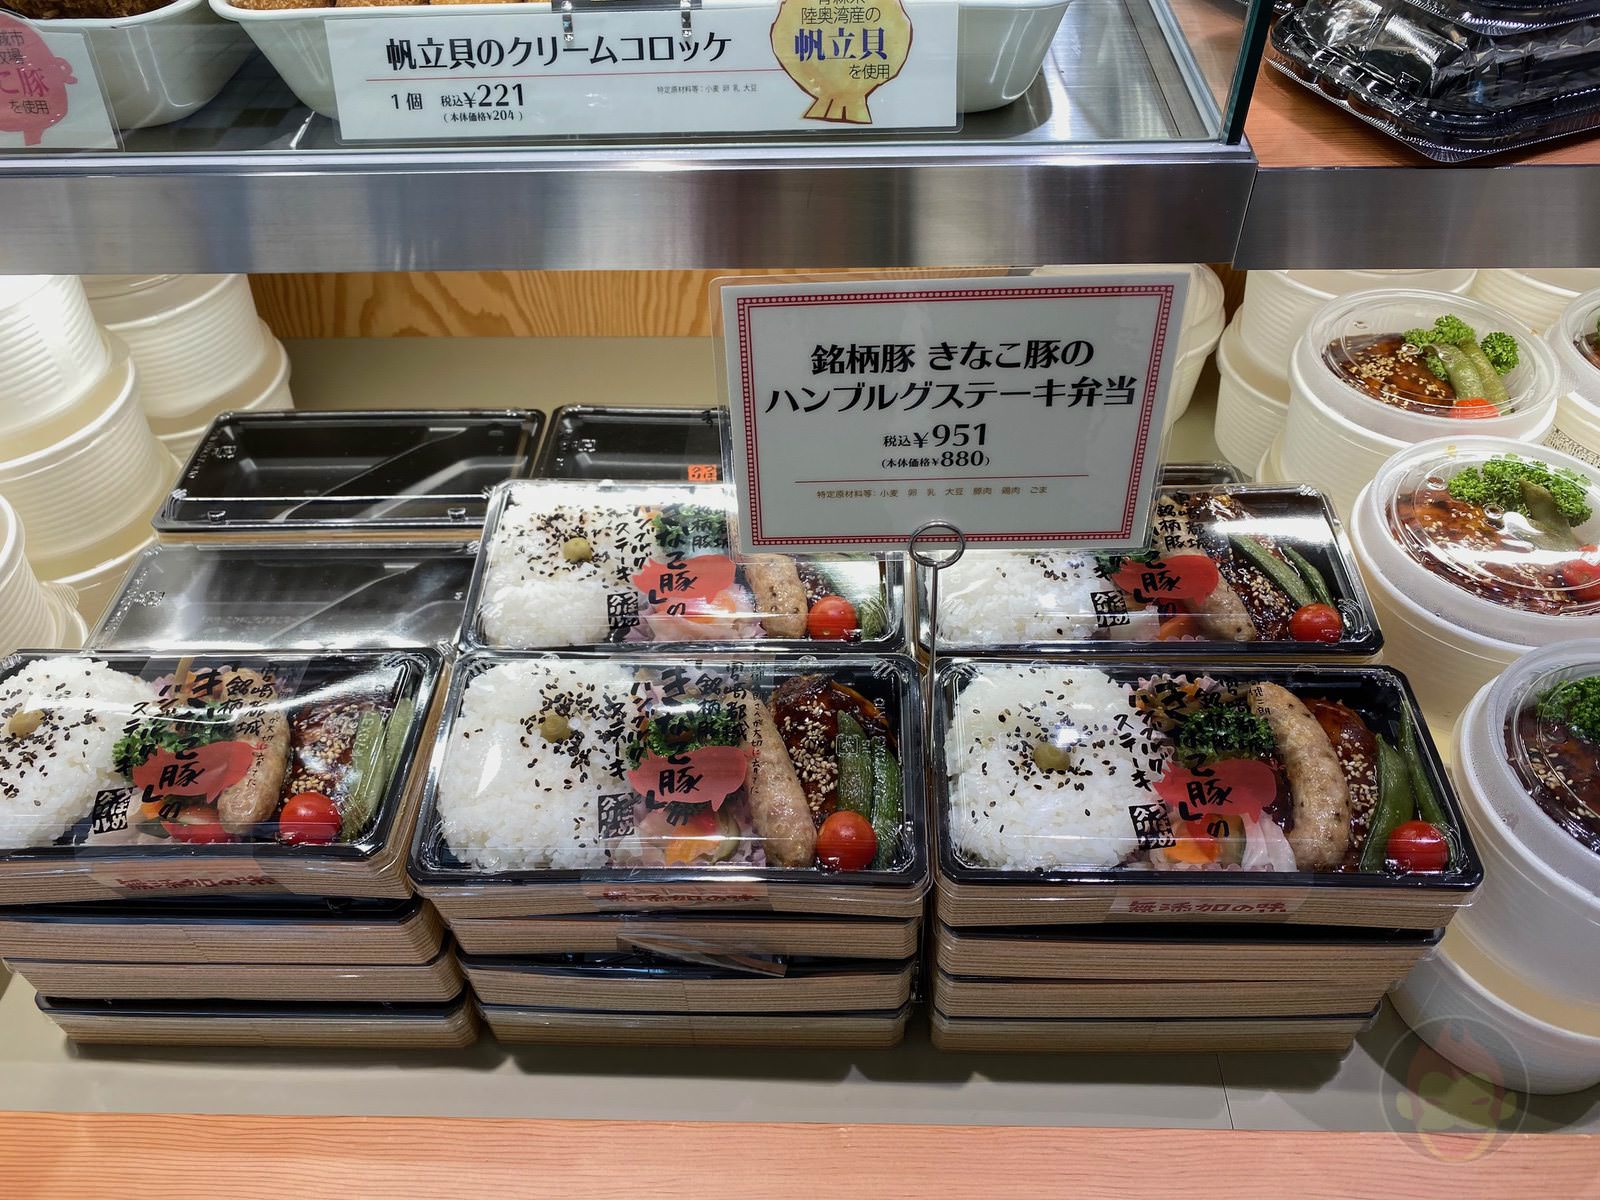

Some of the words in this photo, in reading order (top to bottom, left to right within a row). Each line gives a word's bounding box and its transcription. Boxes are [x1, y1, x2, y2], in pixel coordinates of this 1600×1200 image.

[801, 8, 881, 24] 陸奥湾産の
[386, 32, 732, 71] 帆立貝のクリームコロッケ
[795, 27, 888, 62] 帆立貝
[849, 64, 890, 79] を使用
[9, 100, 49, 115] を使用
[811, 344, 915, 374] 銘柄豚
[928, 340, 1094, 371] きなこ豚の
[765, 375, 1138, 413] ハンブルグステーキ弁当
[927, 487, 936, 497] 乳
[945, 487, 964, 496] 大豆
[973, 486, 992, 496] 豚肉
[1001, 486, 1021, 496] 鶏肉
[1030, 485, 1048, 495] ごま
[1128, 901, 1287, 913] 無添加の味
